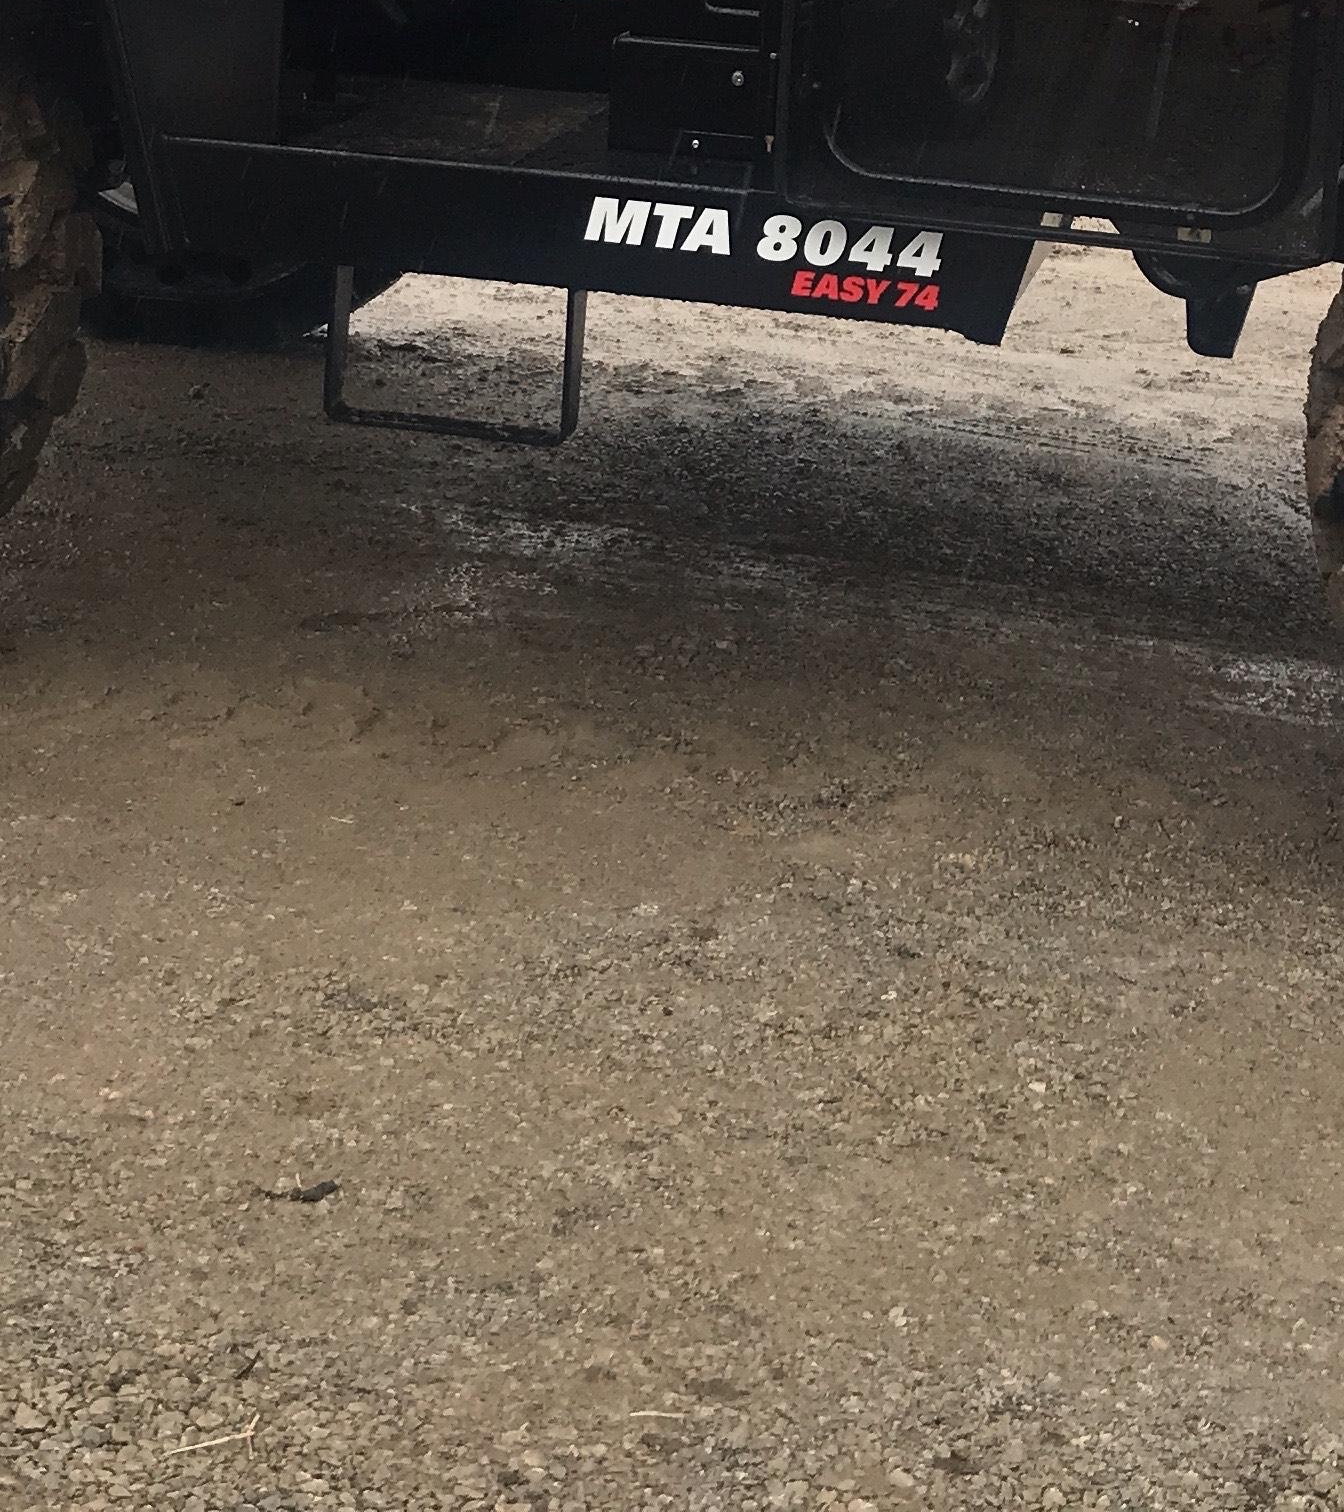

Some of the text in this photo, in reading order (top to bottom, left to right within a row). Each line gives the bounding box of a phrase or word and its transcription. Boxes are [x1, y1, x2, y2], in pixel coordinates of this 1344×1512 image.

[584, 196, 944, 277] MTA 8044
[790, 270, 941, 311] EASY 74
